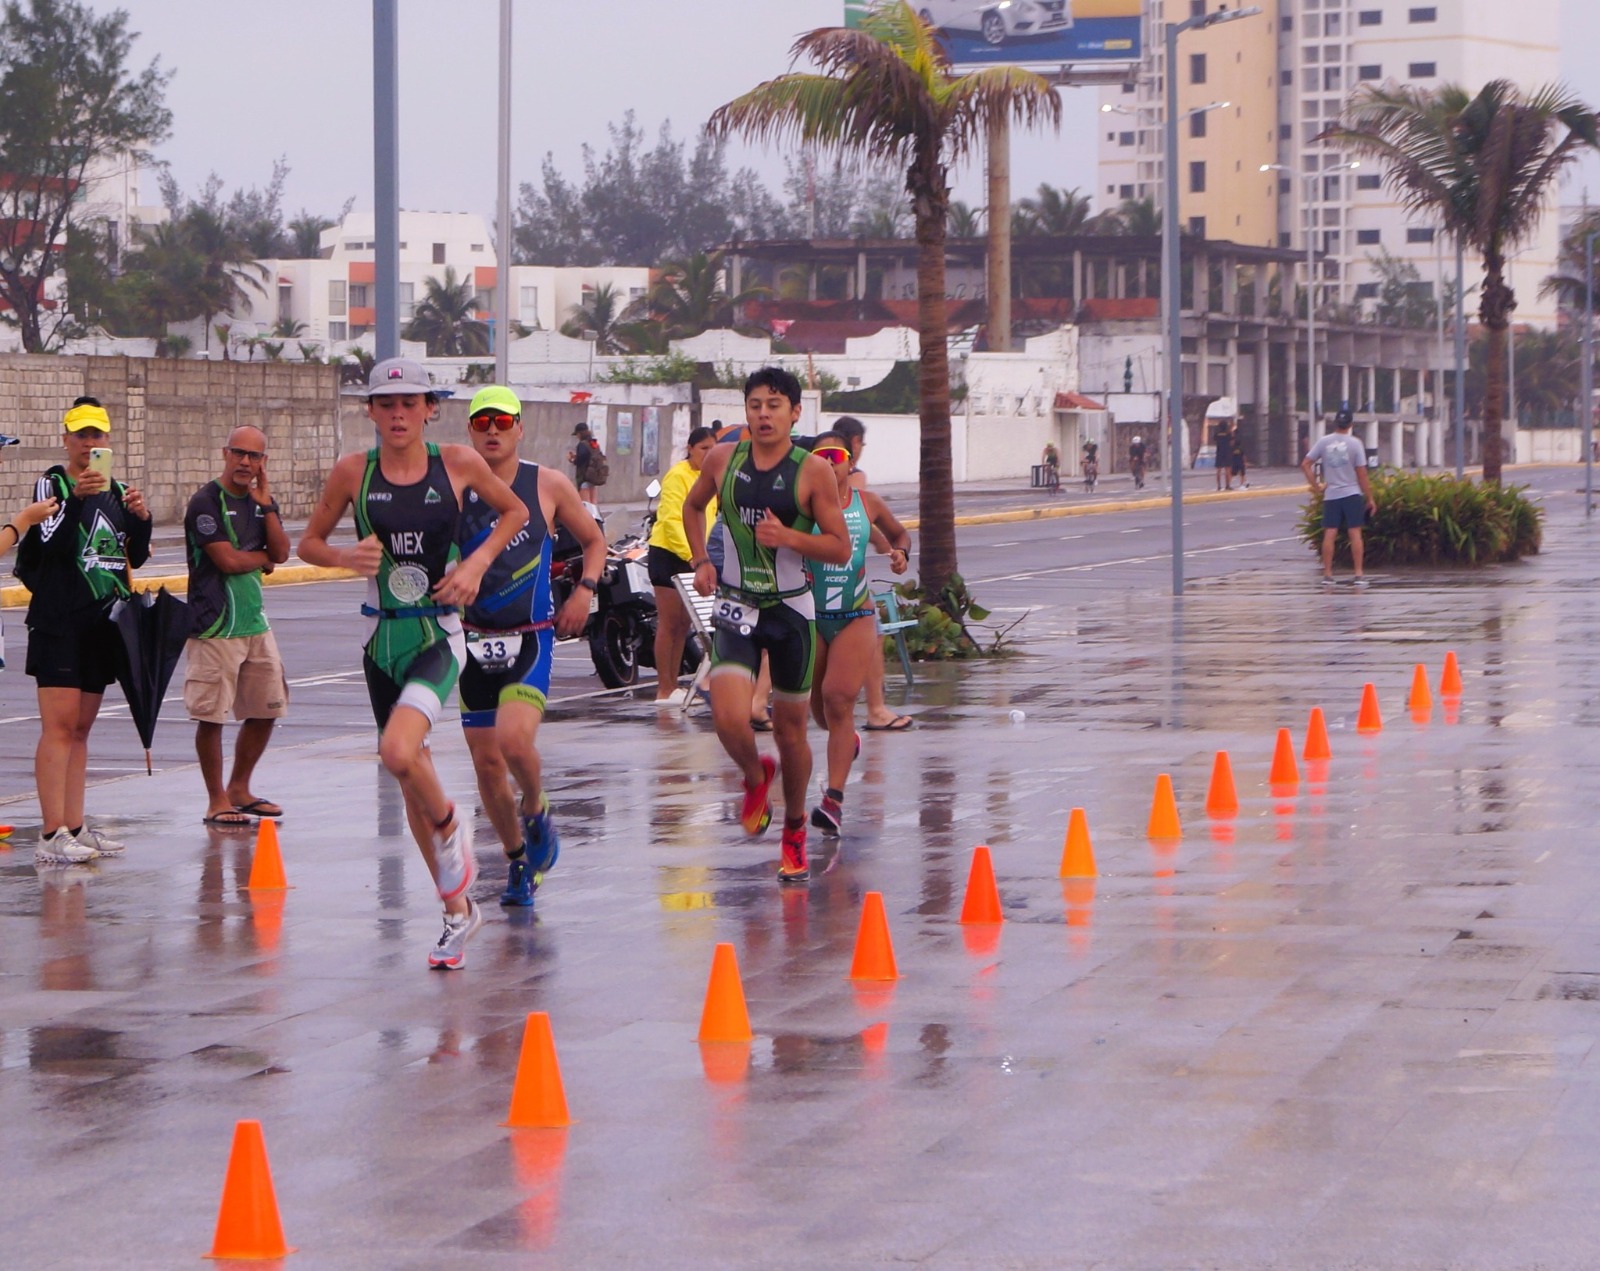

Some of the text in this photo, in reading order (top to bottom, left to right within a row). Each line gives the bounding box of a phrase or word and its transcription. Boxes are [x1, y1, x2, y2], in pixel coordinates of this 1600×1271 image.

[390, 531, 425, 556] MEX
[718, 602, 743, 621] 56
[482, 640, 507, 660] 33
